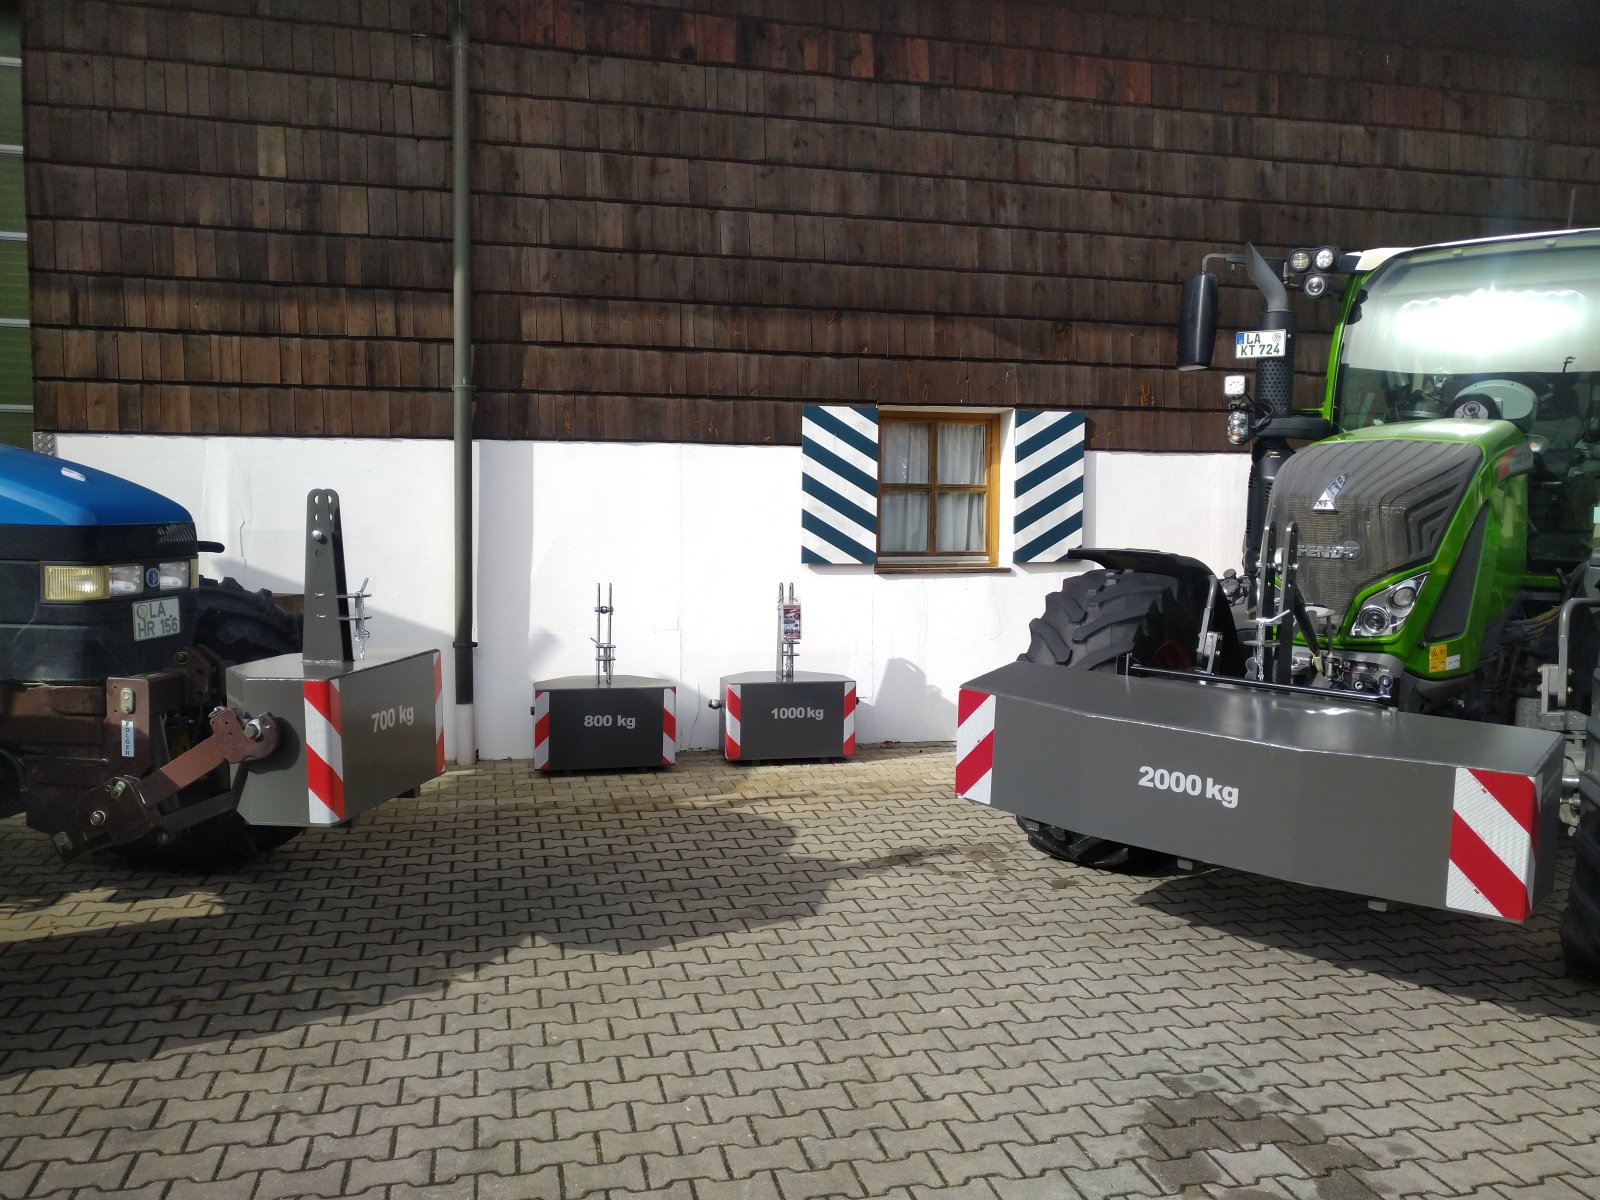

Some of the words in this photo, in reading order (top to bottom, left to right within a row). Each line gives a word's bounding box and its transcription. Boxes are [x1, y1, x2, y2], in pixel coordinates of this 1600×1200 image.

[1246, 333, 1261, 345] LA
[1240, 344, 1256, 356] KT
[1259, 343, 1280, 355] 724
[149, 601, 166, 618] LA
[137, 620, 156, 638] HR
[160, 617, 178, 634] 156
[371, 708, 396, 733] 700
[398, 704, 414, 726] kg
[771, 706, 806, 720] 1000
[806, 706, 824, 721] kg
[583, 714, 613, 727] 800
[617, 714, 636, 730] kg
[1138, 765, 1202, 796] 2000
[1205, 777, 1239, 809] kg
